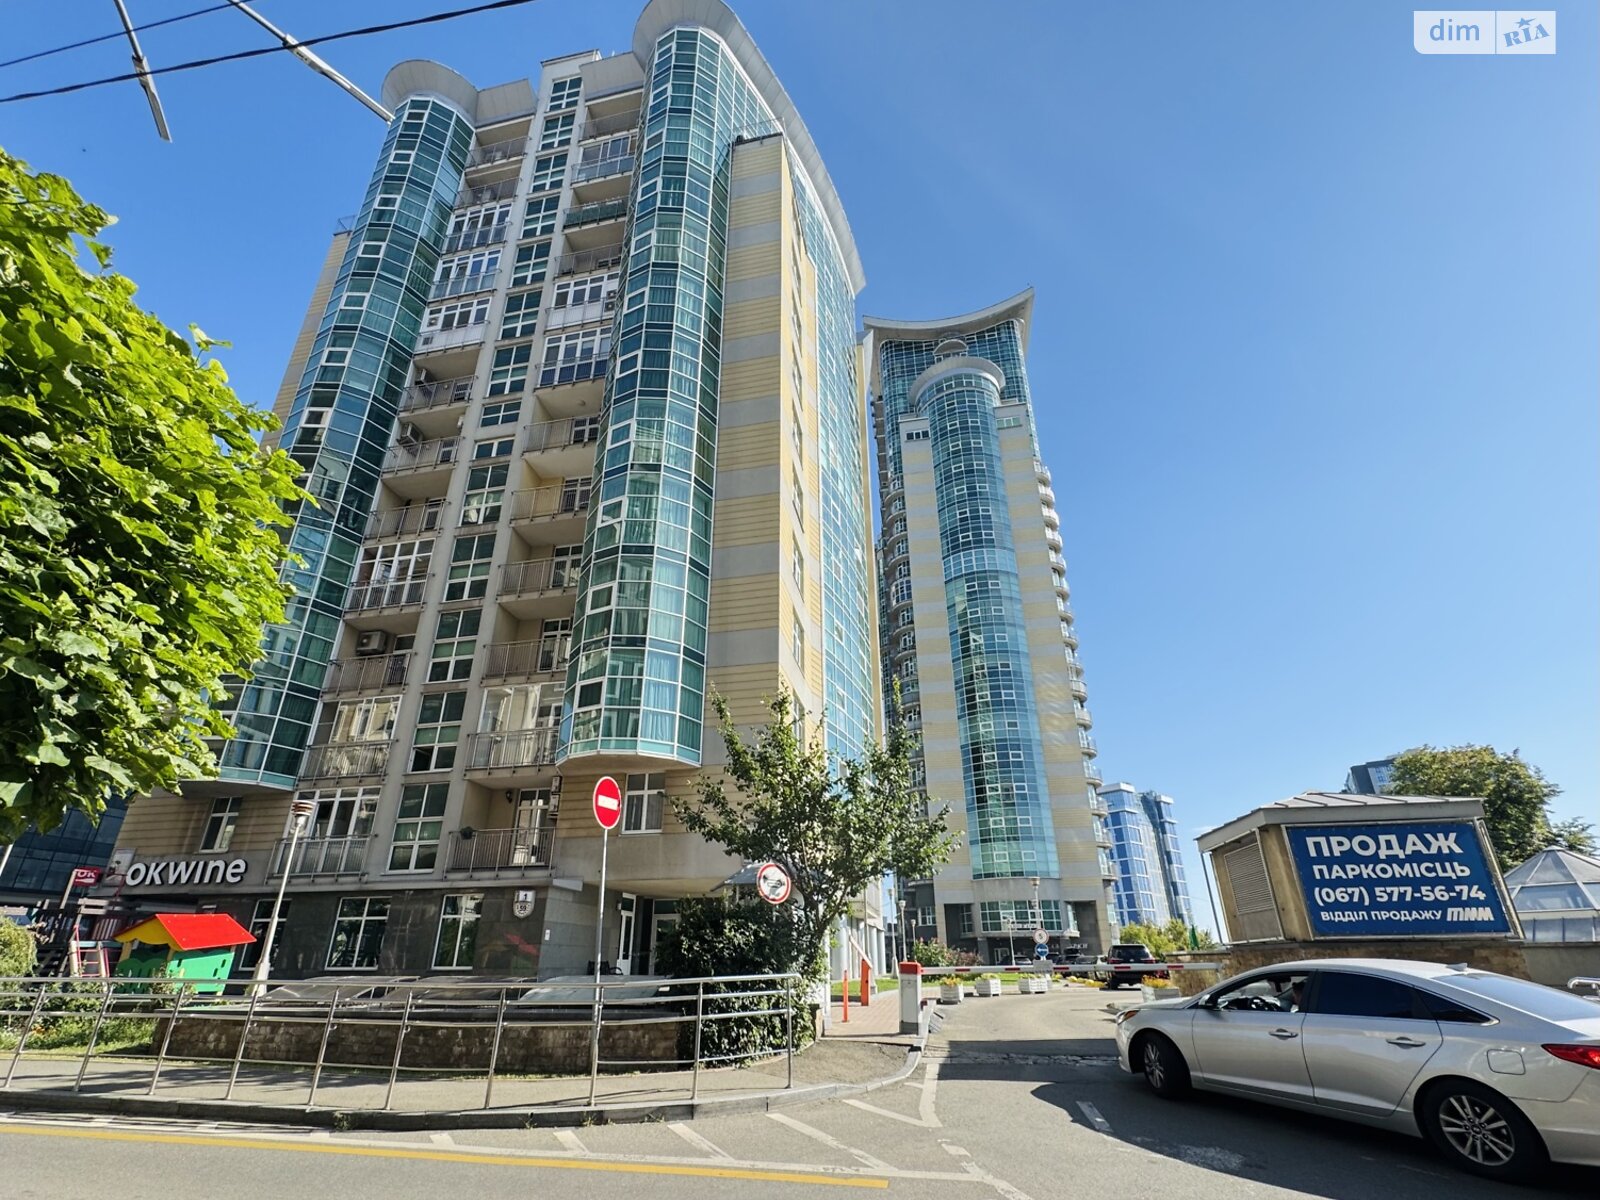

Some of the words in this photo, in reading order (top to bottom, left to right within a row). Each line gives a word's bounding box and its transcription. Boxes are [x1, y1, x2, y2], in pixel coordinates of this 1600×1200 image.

[1305, 832, 1464, 859] ПРОДАЖ
[1312, 861, 1471, 880] ПАРКОМІСЦЬ
[1314, 886, 1370, 907] (067)
[1375, 885, 1487, 902] 577-56-74
[1320, 910, 1368, 923] ВІДДІЛ
[1371, 909, 1443, 922] ПРОДАЖУ
